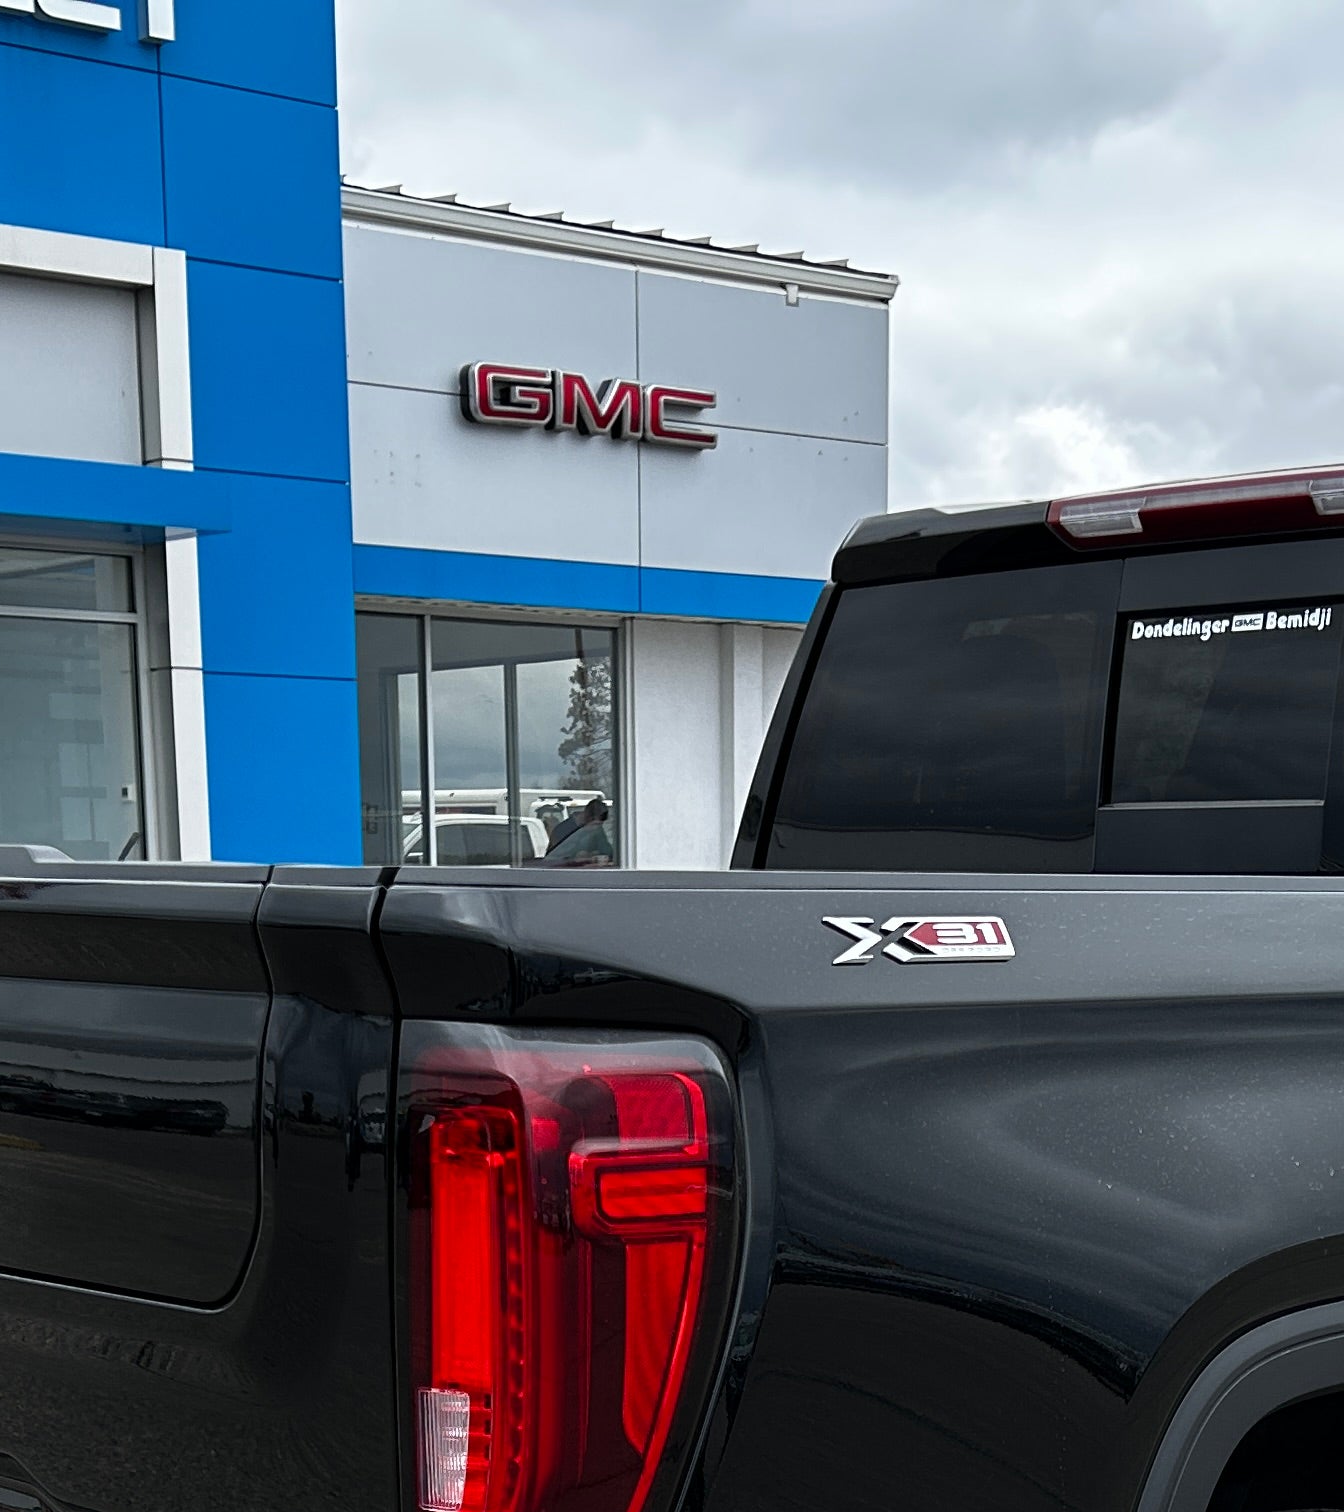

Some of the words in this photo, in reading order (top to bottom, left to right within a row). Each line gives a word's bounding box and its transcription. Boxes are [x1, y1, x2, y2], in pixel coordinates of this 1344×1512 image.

[463, 360, 717, 450] GMC
[1131, 617, 1231, 641] Dondelinger
[1265, 607, 1332, 631] Bemidji
